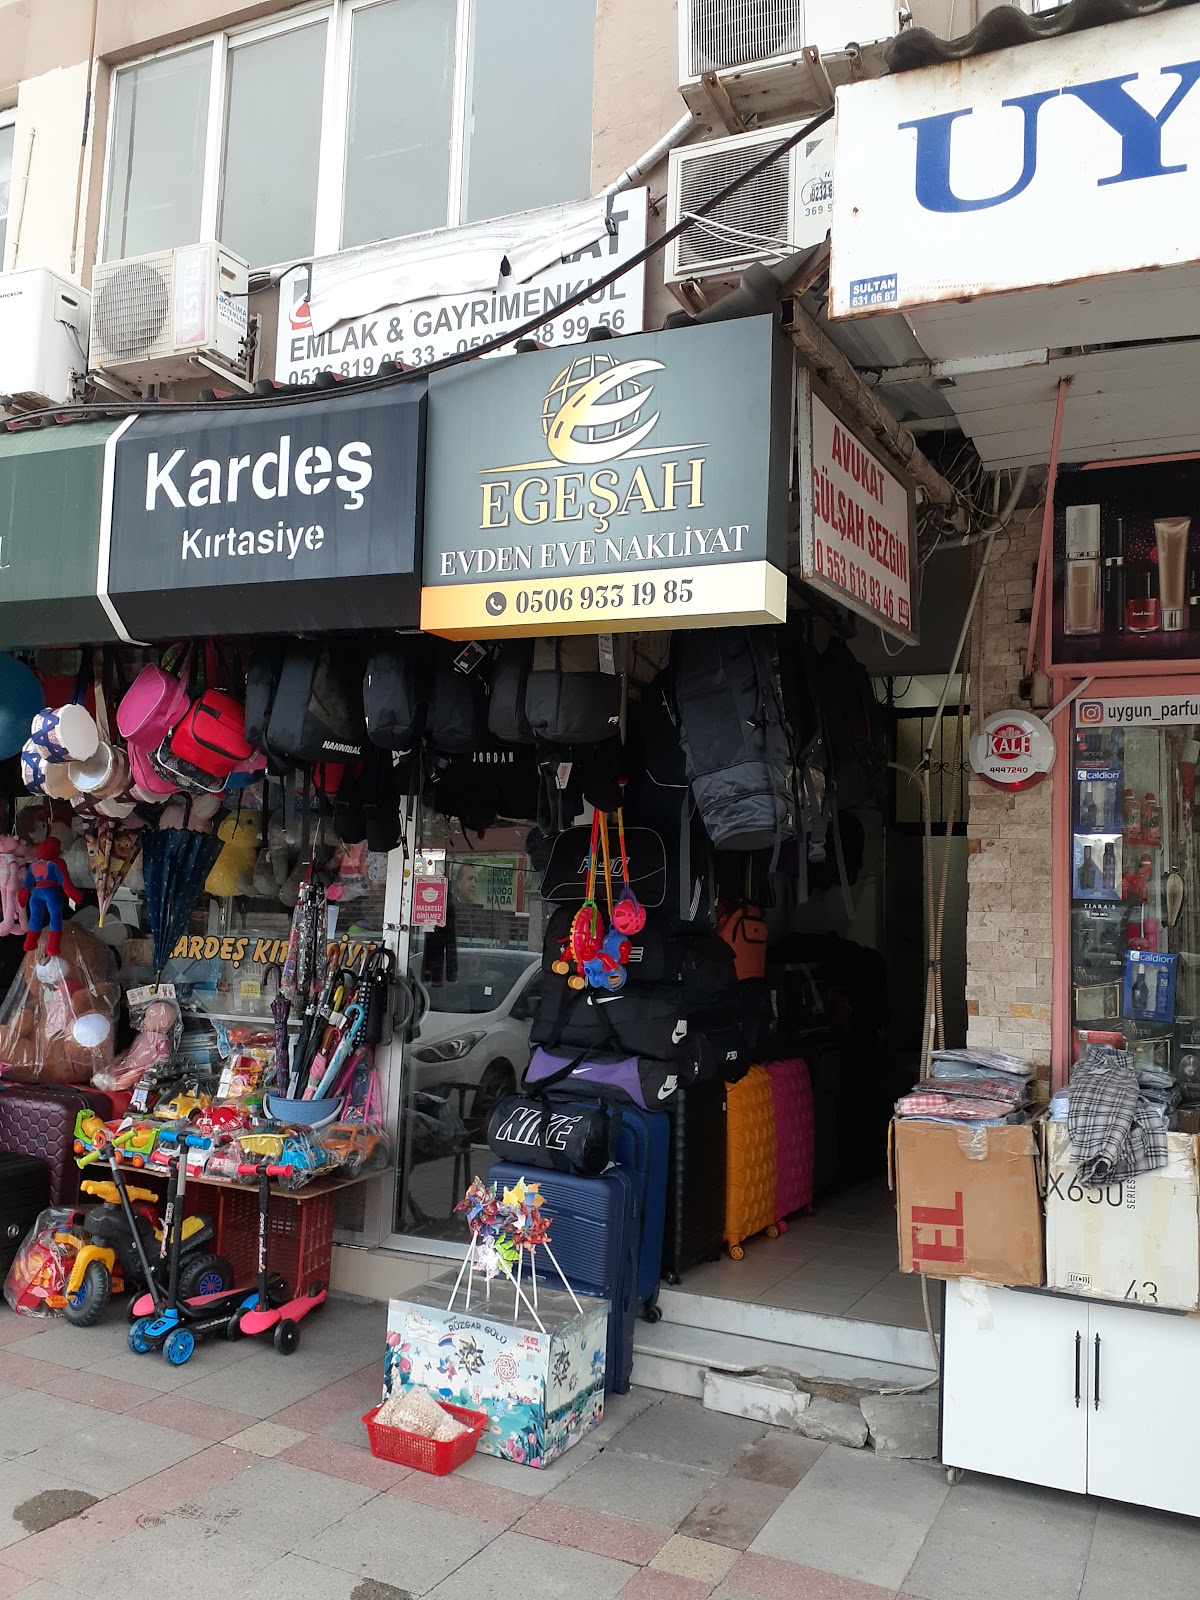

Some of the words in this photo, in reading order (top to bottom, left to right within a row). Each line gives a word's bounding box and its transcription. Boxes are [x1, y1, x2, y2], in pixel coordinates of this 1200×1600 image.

[805, 205, 823, 217] 369
[852, 294, 868, 307] 631
[871, 292, 883, 304] 06
[884, 290, 896, 301] 87
[853, 278, 896, 295] SULTAN
[290, 321, 379, 363] EMLAK
[386, 317, 404, 344] &
[339, 356, 374, 377] 819
[411, 345, 435, 367] 33
[562, 316, 589, 340] 99
[598, 309, 625, 330] 56
[145, 434, 374, 512] Kardeş
[831, 424, 885, 507] AVUKAT
[479, 458, 706, 534] EGEŞAH
[813, 464, 865, 551] GÜLŞAH
[867, 515, 908, 584] SEZGİN
[181, 520, 325, 561] Kırtasiye
[439, 545, 533, 577] EVDEN
[539, 538, 597, 570] EVE
[604, 524, 750, 564] NAKLİYAT
[815, 538, 824, 575] 0
[826, 544, 847, 589] 553
[849, 560, 868, 603] 613
[869, 575, 881, 612] 93
[883, 585, 894, 621] 46
[515, 586, 574, 614] 0506
[580, 583, 625, 609] 933
[631, 581, 657, 607] 19
[663, 578, 694, 603] 85
[1108, 699, 1200, 723] uygun_parfu
[322, 740, 362, 755] HANNIBAL
[987, 734, 1032, 756] KALE
[472, 752, 514, 763] JORDAN
[989, 766, 1028, 774] 4447240
[1087, 771, 1119, 780] caldion
[1075, 847, 1083, 866] night
[415, 904, 443, 912] MASKESİZ
[416, 912, 441, 920] GİRİLMEZ
[1140, 953, 1175, 964] caldion
[495, 1106, 584, 1151] NIKE
[1126, 1179, 1136, 1210] SERIES
[911, 1191, 965, 1272] EL
[1123, 1279, 1158, 1303] 43
[448, 1320, 481, 1333] RÜZGAR
[484, 1326, 508, 1345] GÜLÜ
